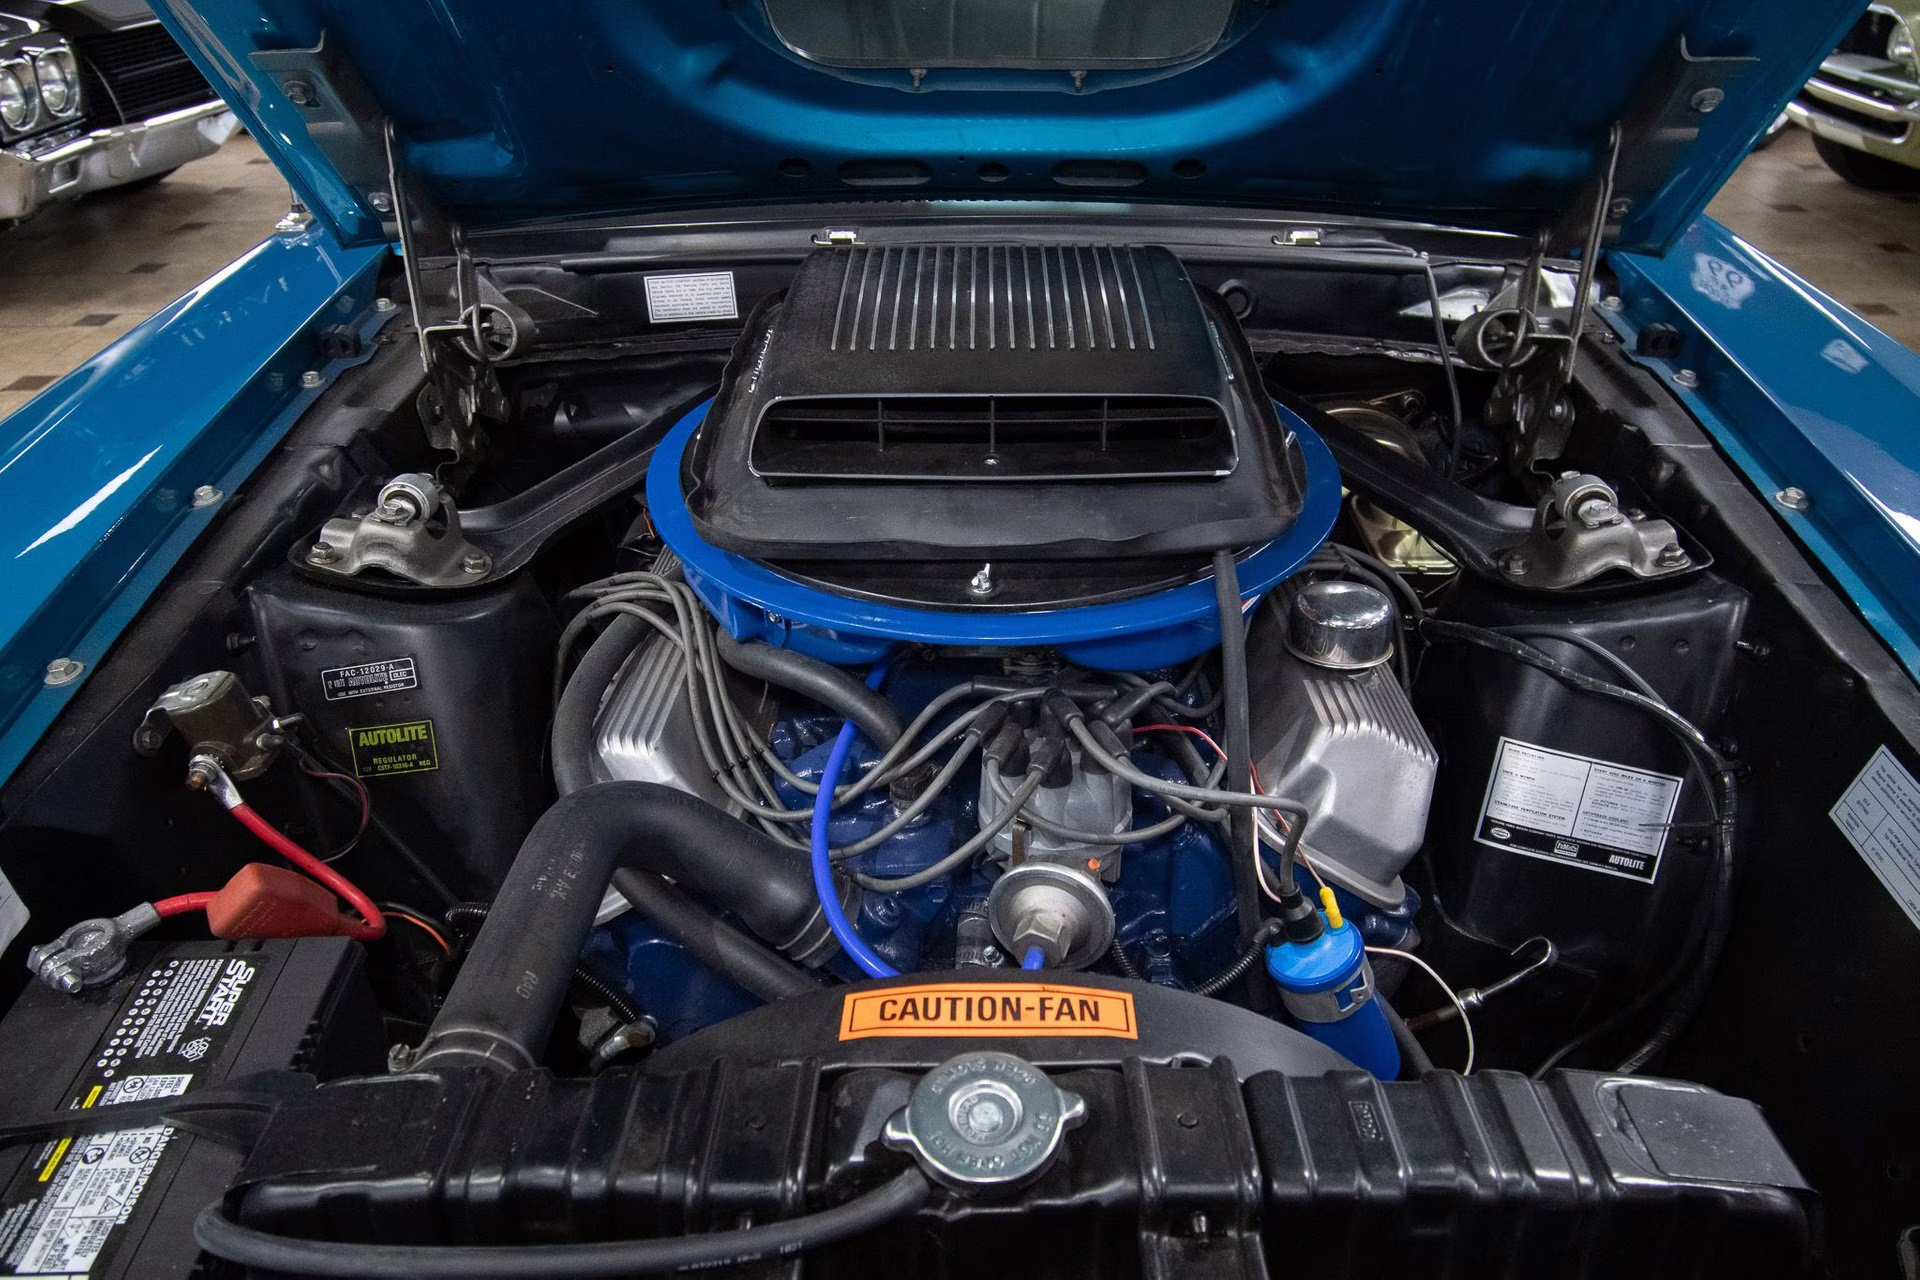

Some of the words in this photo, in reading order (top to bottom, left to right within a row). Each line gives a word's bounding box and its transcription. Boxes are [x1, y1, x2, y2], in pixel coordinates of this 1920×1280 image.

[340, 663, 394, 677] FAC-12029-A
[359, 725, 428, 747] AUTOLITE
[373, 753, 417, 764] REGULATOR
[1608, 854, 1645, 870] AUTOLITE
[201, 958, 247, 1026] START
[213, 964, 255, 1026] SUPER
[879, 996, 1100, 1022] CAUTION-FAN
[115, 1127, 174, 1225] DANGER/POISON
